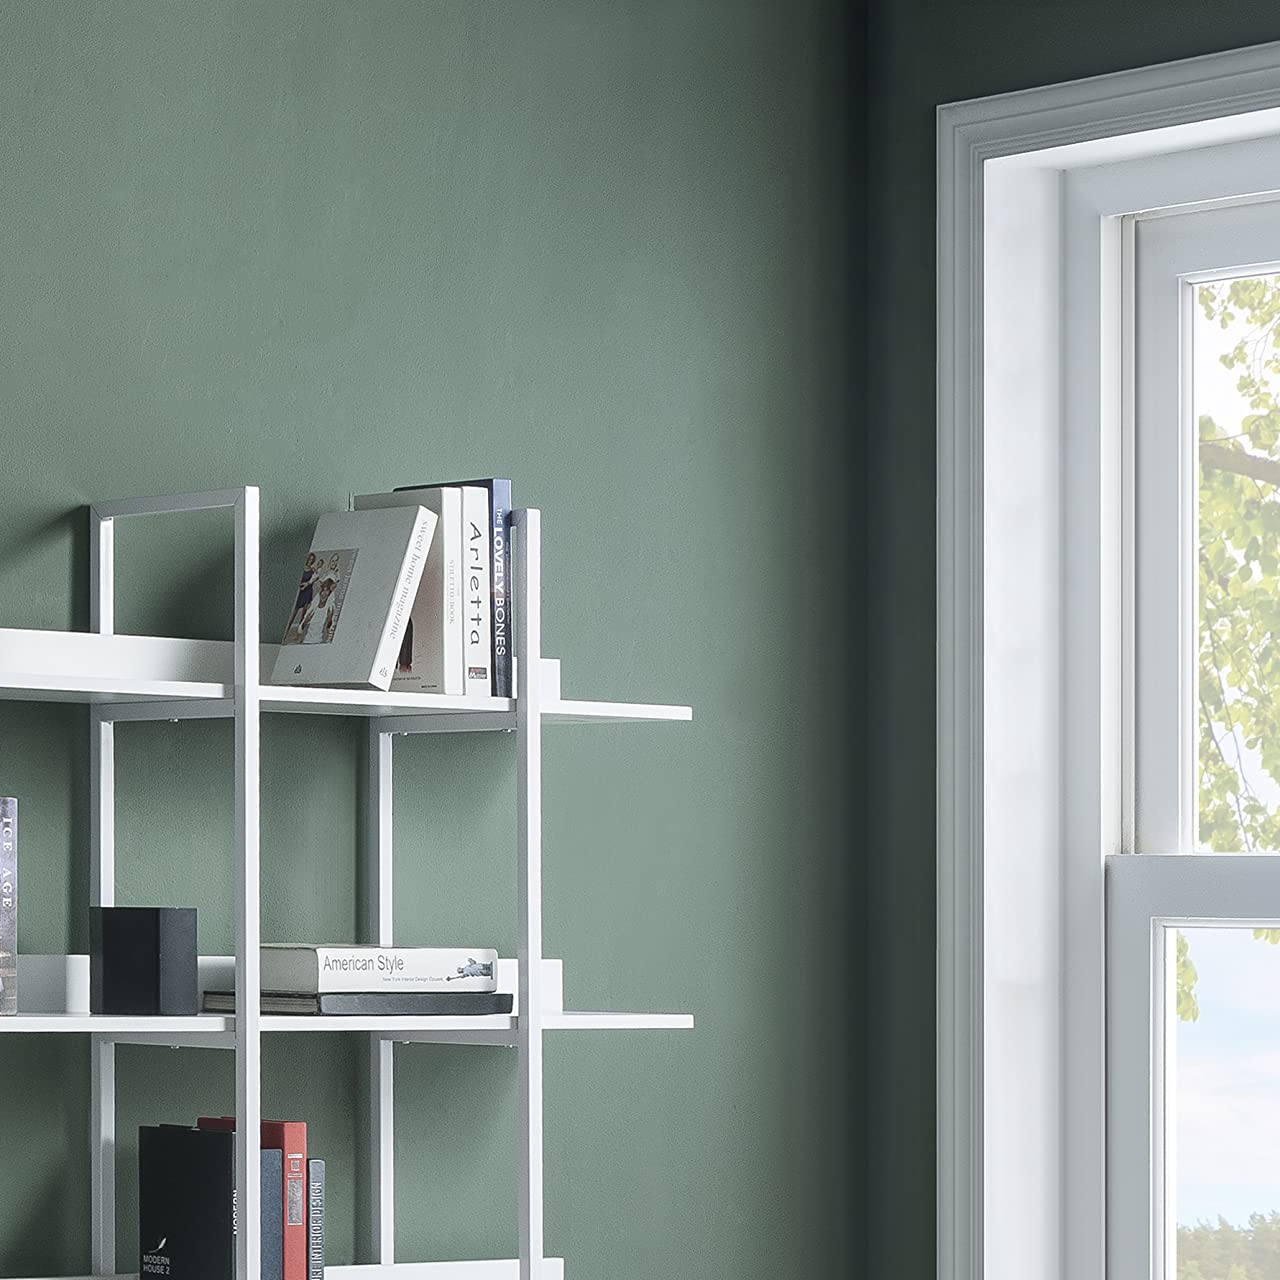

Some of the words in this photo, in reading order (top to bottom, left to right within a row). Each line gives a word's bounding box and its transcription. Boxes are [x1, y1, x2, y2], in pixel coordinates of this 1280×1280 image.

[414, 519, 428, 553] sweet
[408, 554, 421, 586] home
[494, 527, 504, 594] LOVELY
[470, 522, 483, 646] Arletta
[390, 586, 410, 640] magazine
[495, 598, 506, 656] BONES
[3, 816, 13, 852] ICE
[2, 868, 13, 909] AGE
[324, 955, 374, 971] American
[378, 954, 404, 974] Style
[312, 1182, 322, 1216] DESIGN
[312, 1219, 322, 1264] INTERIOR
[143, 1254, 170, 1266] MODERN
[143, 1265, 164, 1274] HOUSE
[165, 1266, 170, 1275] 2
